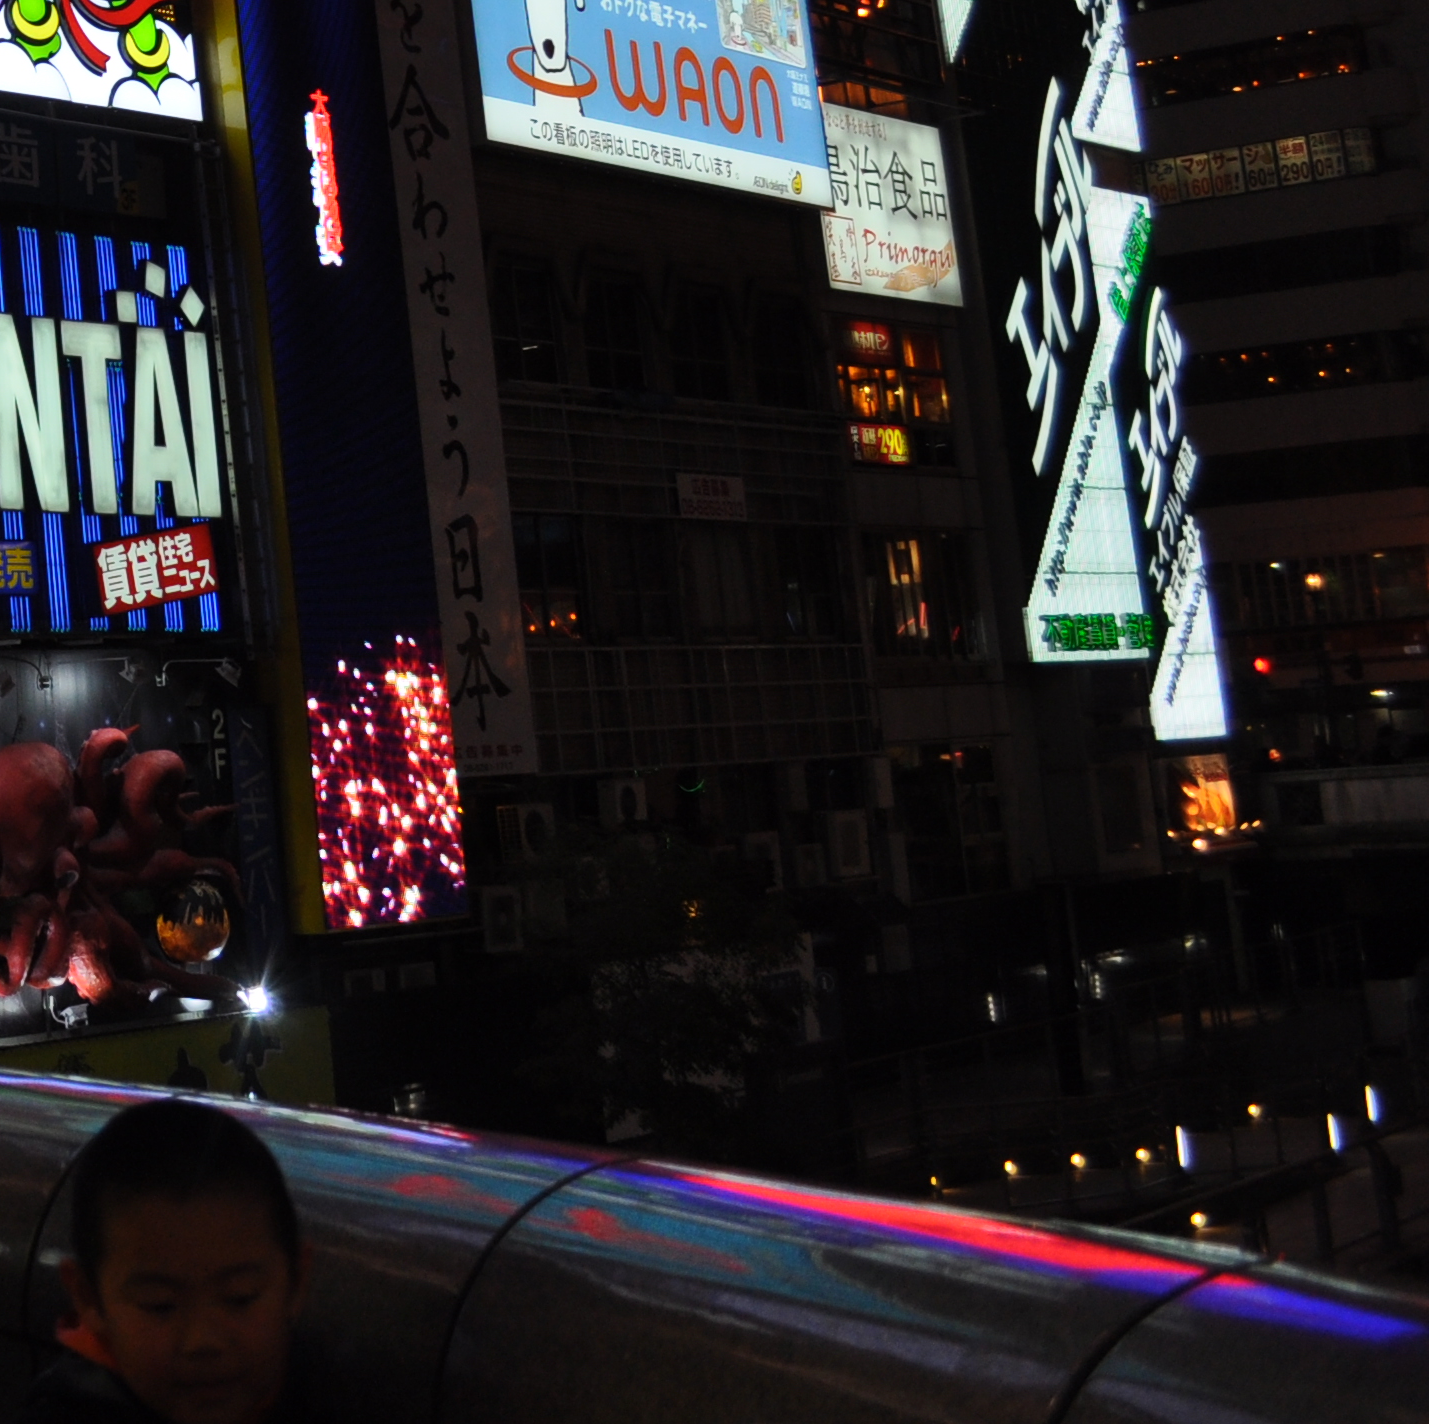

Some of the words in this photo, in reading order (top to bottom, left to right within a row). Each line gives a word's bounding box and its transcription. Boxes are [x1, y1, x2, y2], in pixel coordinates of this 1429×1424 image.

[604, 28, 784, 143] WAON
[530, 118, 740, 180] この看板の照明はLEDを使用しています。
[1181, 148, 1259, 175] マッサージ
[1006, 116, 1093, 411] エイブル
[1129, 311, 1181, 492] エイブル
[211, 708, 228, 780] 2F
